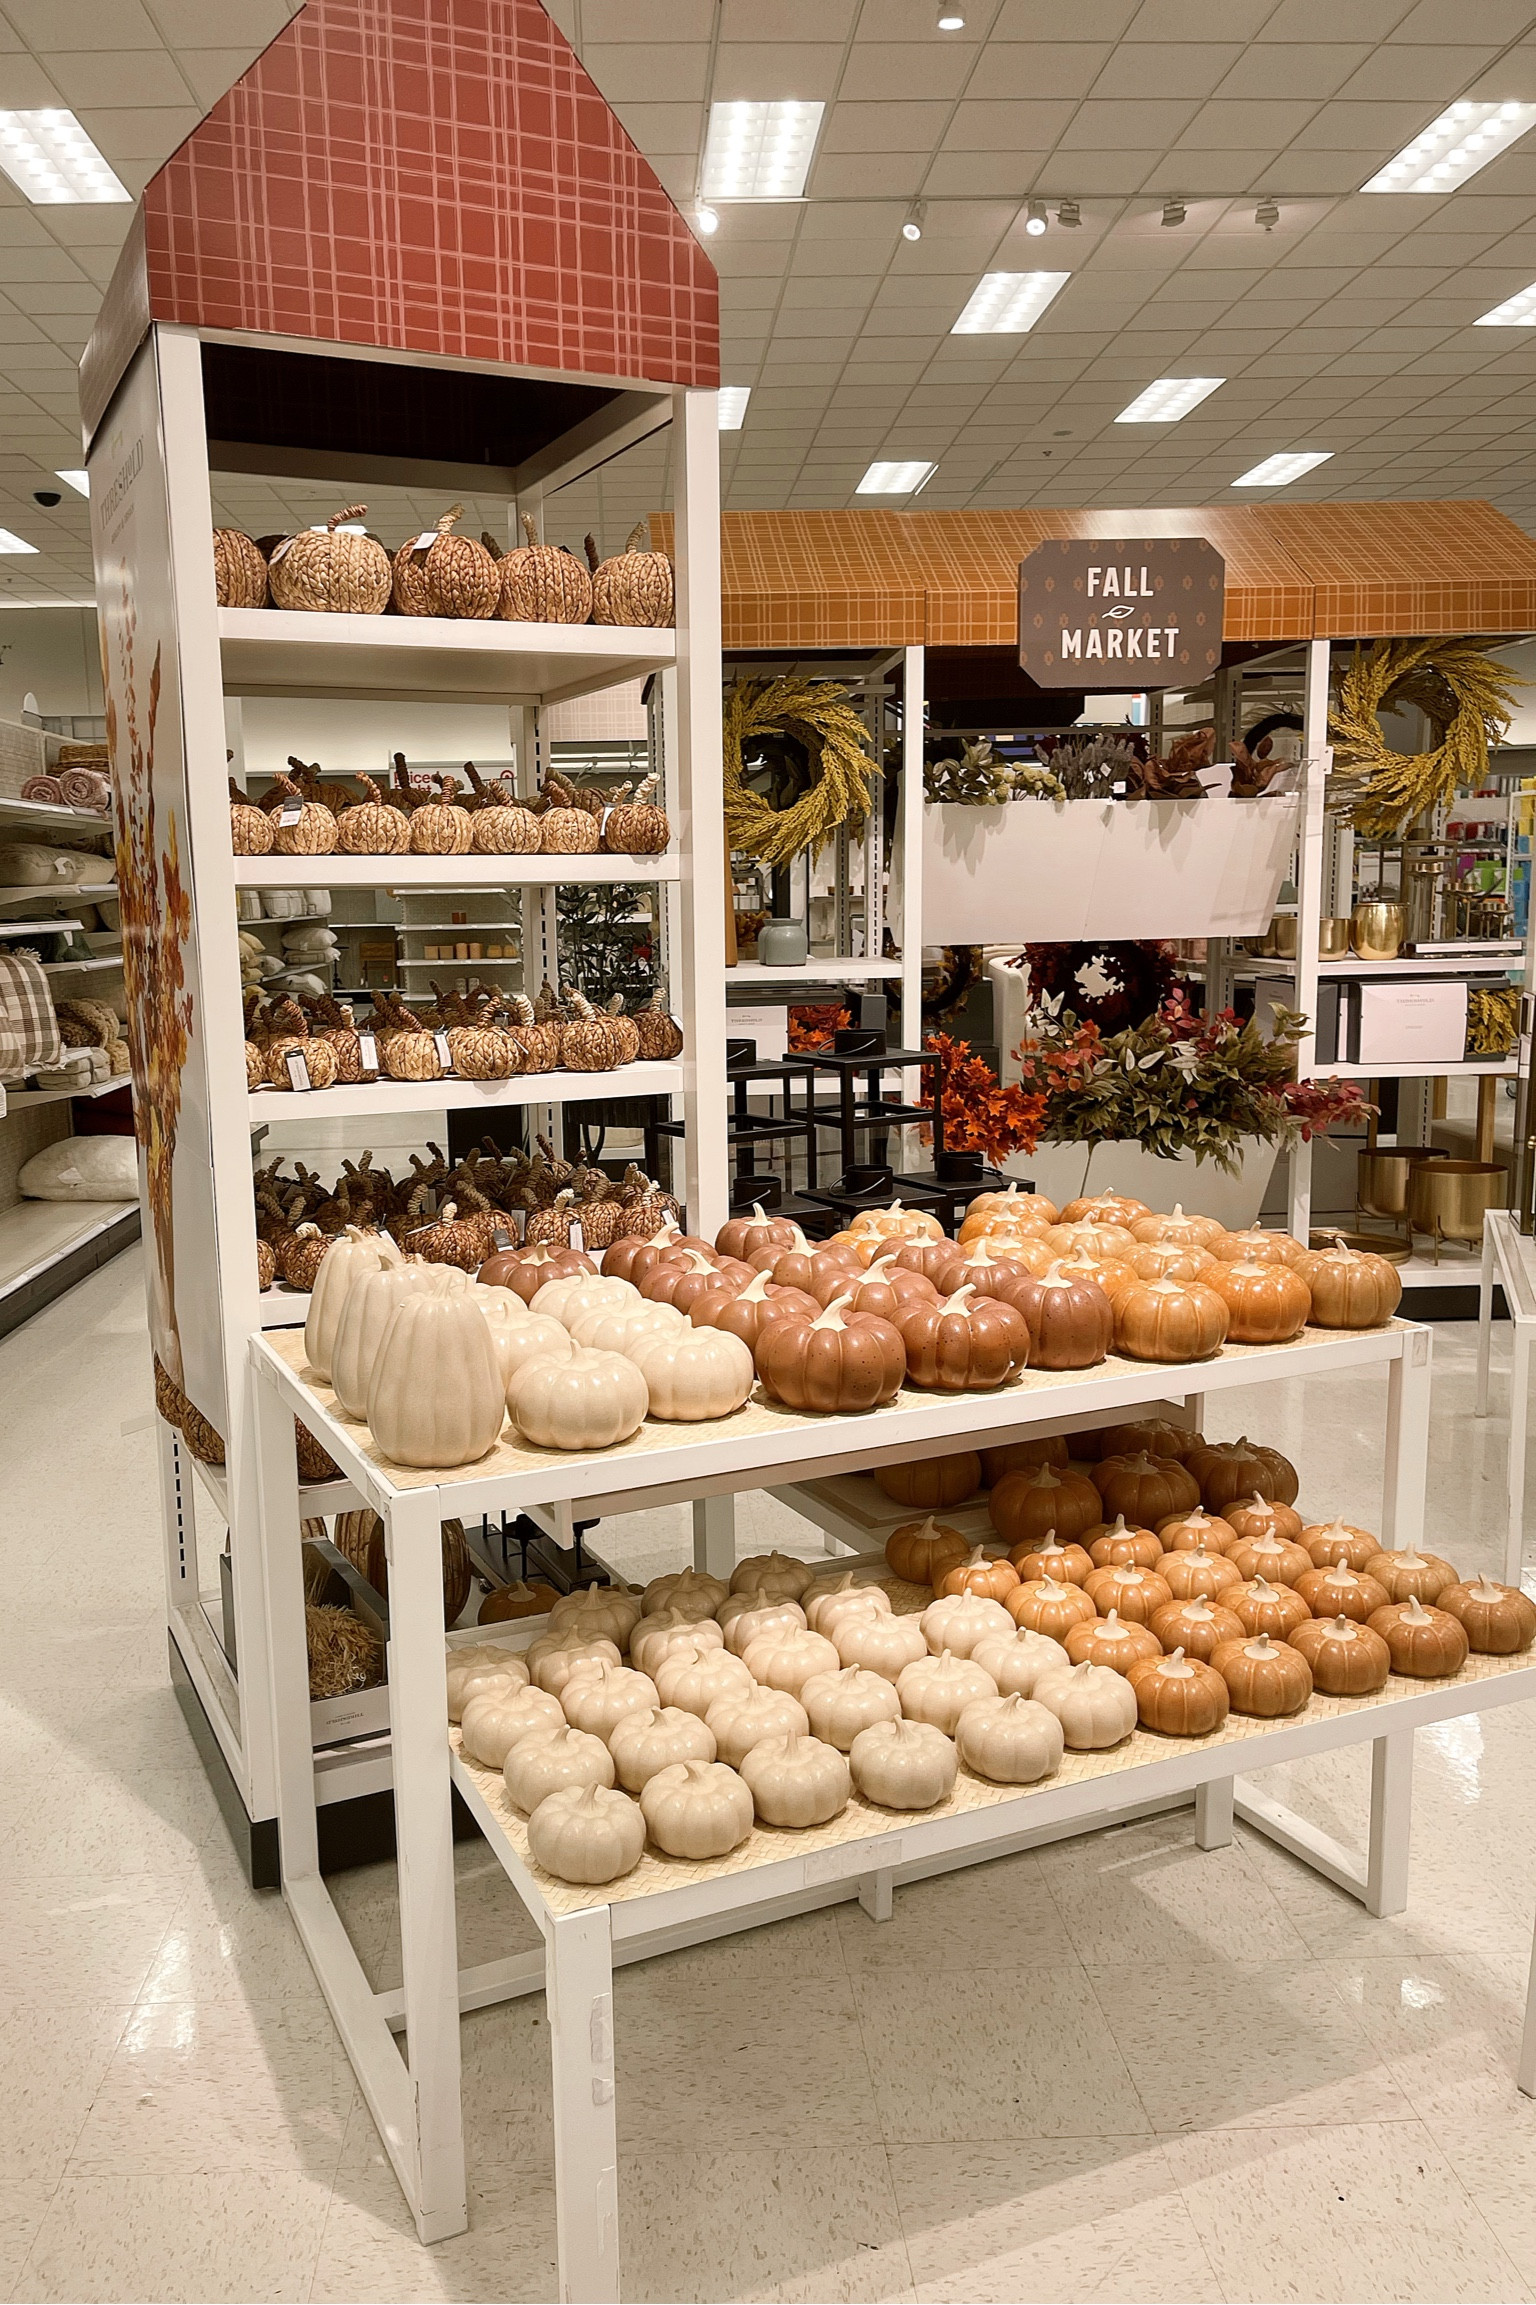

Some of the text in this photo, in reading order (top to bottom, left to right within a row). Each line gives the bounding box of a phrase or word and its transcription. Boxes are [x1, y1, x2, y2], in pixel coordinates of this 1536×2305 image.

[100, 438, 144, 531] THRESHOLD
[1087, 566, 1154, 597] FALL
[1061, 628, 1179, 659] MARKET
